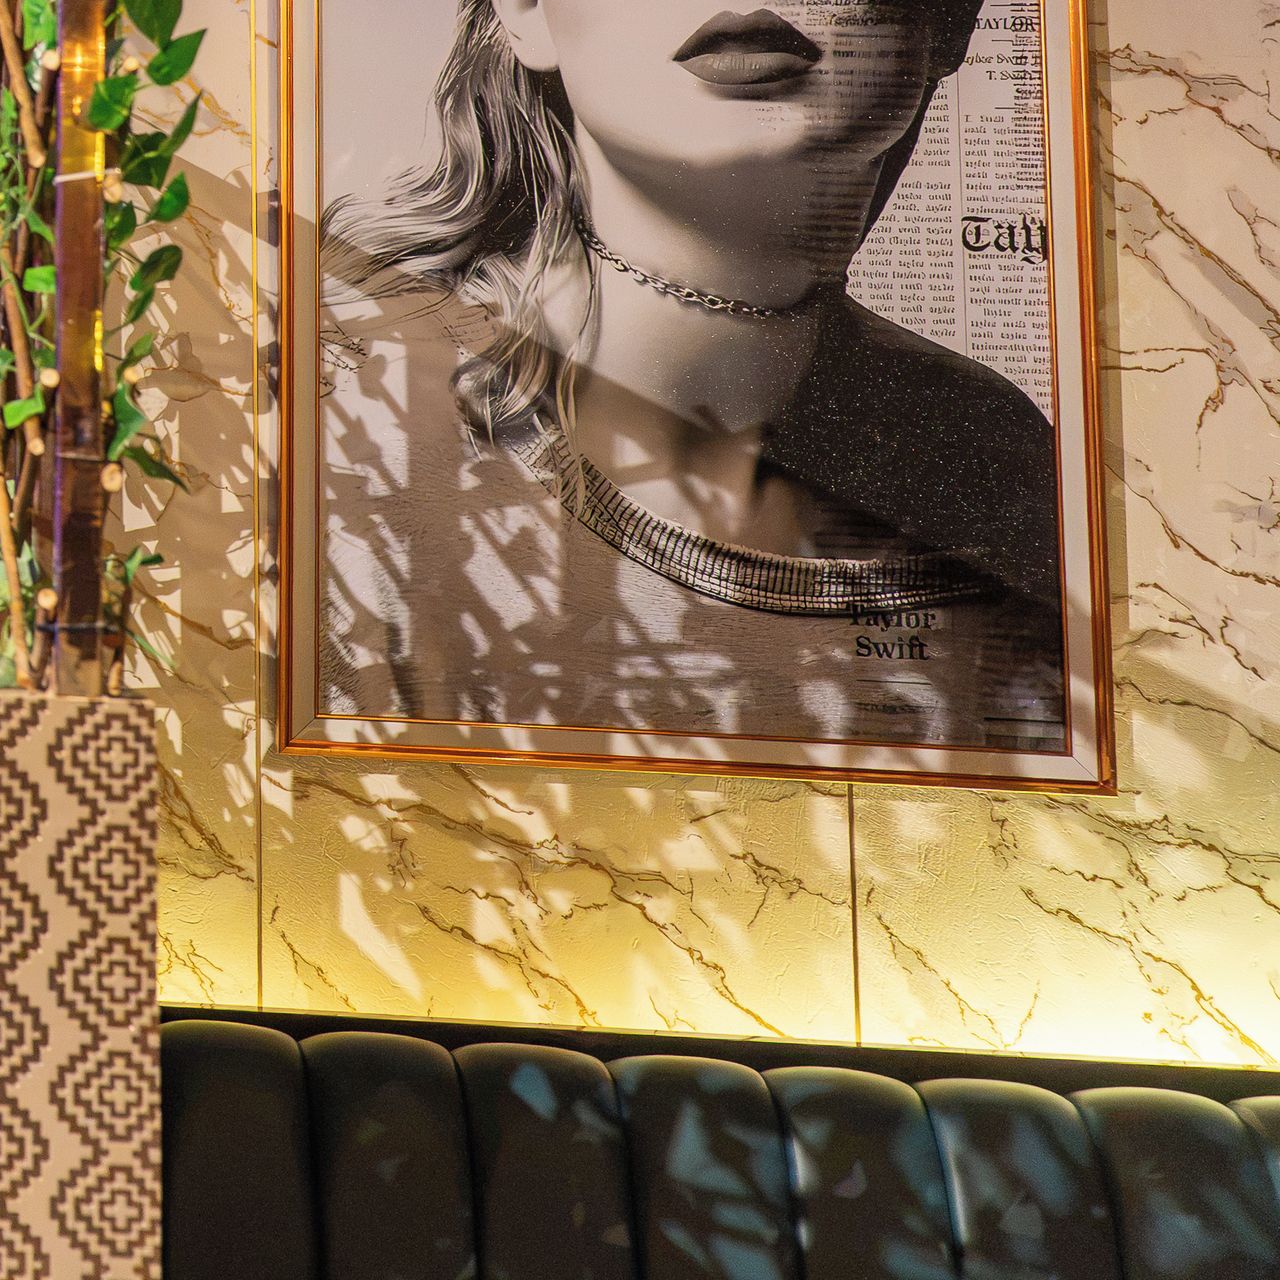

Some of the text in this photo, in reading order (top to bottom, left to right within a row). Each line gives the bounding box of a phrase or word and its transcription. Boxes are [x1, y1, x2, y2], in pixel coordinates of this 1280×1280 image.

[975, 17, 1036, 32] TAYLOR
[847, 604, 937, 631] Taylor
[856, 635, 931, 660] Swift
